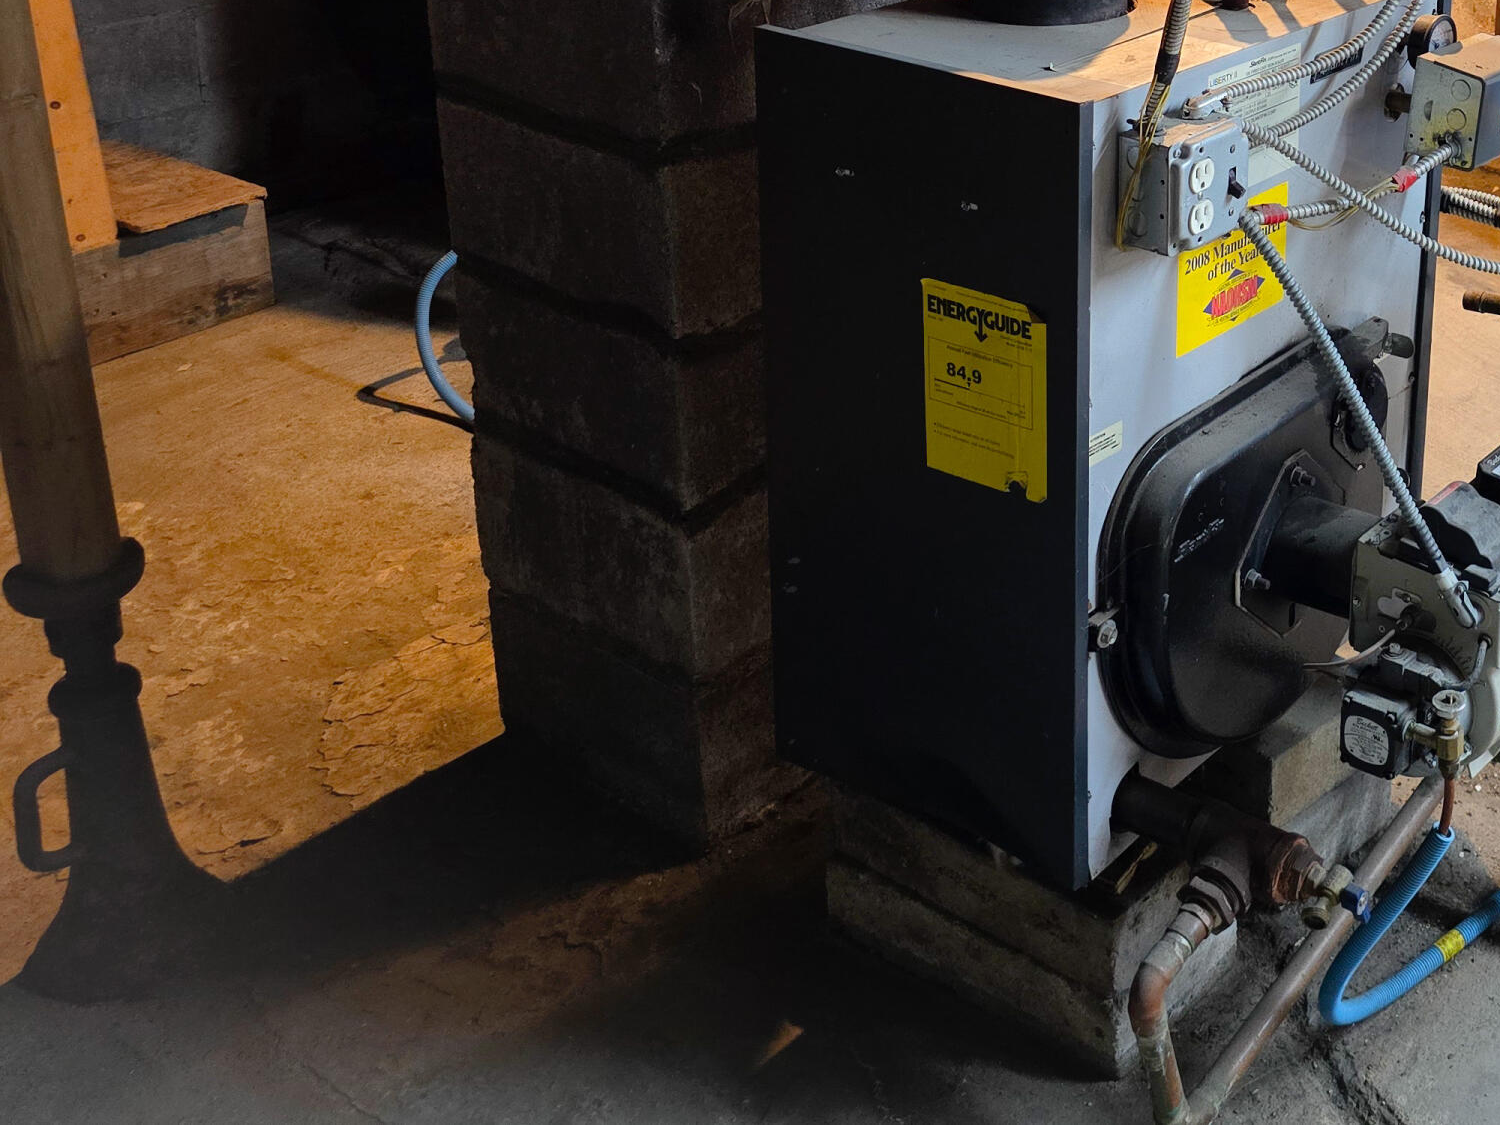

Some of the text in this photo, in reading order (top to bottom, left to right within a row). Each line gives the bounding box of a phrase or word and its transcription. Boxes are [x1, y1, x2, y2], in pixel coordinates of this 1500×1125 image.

[1185, 222, 1281, 275] 2008 Manufurer
[1207, 263, 1219, 281] of
[1220, 257, 1237, 275] the
[1238, 244, 1264, 267] Year
[927, 294, 1033, 342] ENERGYGUIDE
[946, 362, 982, 385] 84.9
